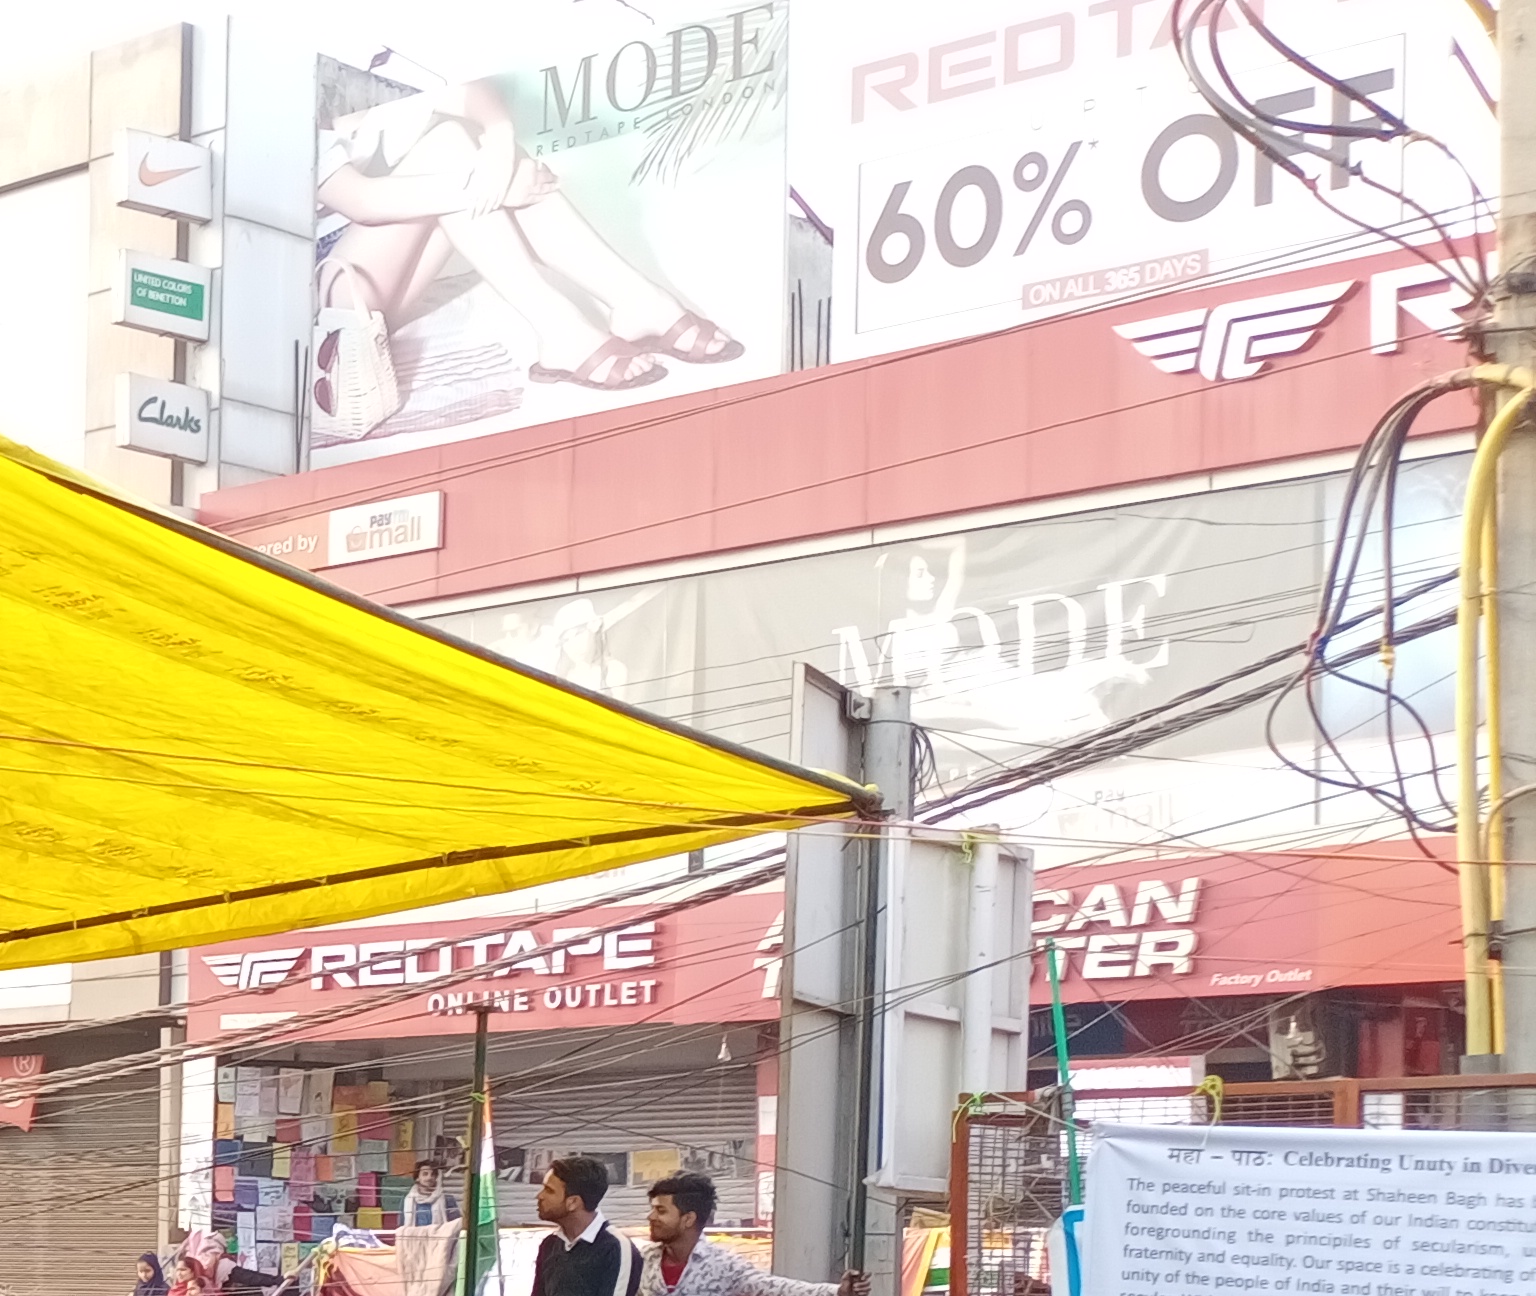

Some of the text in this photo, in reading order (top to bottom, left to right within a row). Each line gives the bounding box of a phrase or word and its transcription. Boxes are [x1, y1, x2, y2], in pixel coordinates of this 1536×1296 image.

[536, 2, 776, 136] MODE
[536, 80, 775, 157] REDTAPE LONDON
[1141, 68, 1395, 223] OFF
[134, 273, 193, 295] UNITED COLORS
[1029, 253, 1201, 306] ON ALL 365 DAYS
[136, 287, 187, 307] OF BENETTON
[138, 396, 202, 433] Clarks
[297, 534, 319, 553] by
[369, 516, 422, 550] mall
[831, 572, 1171, 697] MODE
[310, 921, 658, 990] REDTAPE
[1210, 969, 1313, 988] Factory Outlet
[428, 979, 659, 1016] ONLINE OUTLET
[1284, 1150, 1392, 1174] Celebrating
[1463, 1156, 1481, 1173] in
[1127, 1178, 1523, 1210] The peaceful sit-in protest at Shaheen Bagh has
[1127, 1199, 1188, 1217] founded
[1195, 1206, 1213, 1218] on
[1221, 1203, 1246, 1220] the
[1253, 1208, 1286, 1221] core
[1294, 1207, 1343, 1224] values
[1351, 1209, 1366, 1225] of
[1374, 1213, 1402, 1226] our
[1409, 1211, 1458, 1229] Indian
[1125, 1221, 1236, 1246] foregrounding
[1248, 1227, 1274, 1244] the
[1383, 1235, 1400, 1251] of
[1122, 1266, 1160, 1287] unity
[1165, 1268, 1180, 1284] of
[1185, 1269, 1210, 1286] the
[1215, 1273, 1269, 1292] people
[1275, 1275, 1290, 1291] of
[1297, 1276, 1334, 1293] India
[1341, 1279, 1370, 1295] and
[1124, 1244, 1192, 1267] fraternity
[1197, 1249, 1225, 1265] and
[1303, 1254, 1332, 1271] Our
[1337, 1259, 1382, 1276] space
[1388, 1258, 1399, 1274] is
[1406, 1263, 1414, 1275] a
[1421, 1261, 1513, 1284] celebrating
